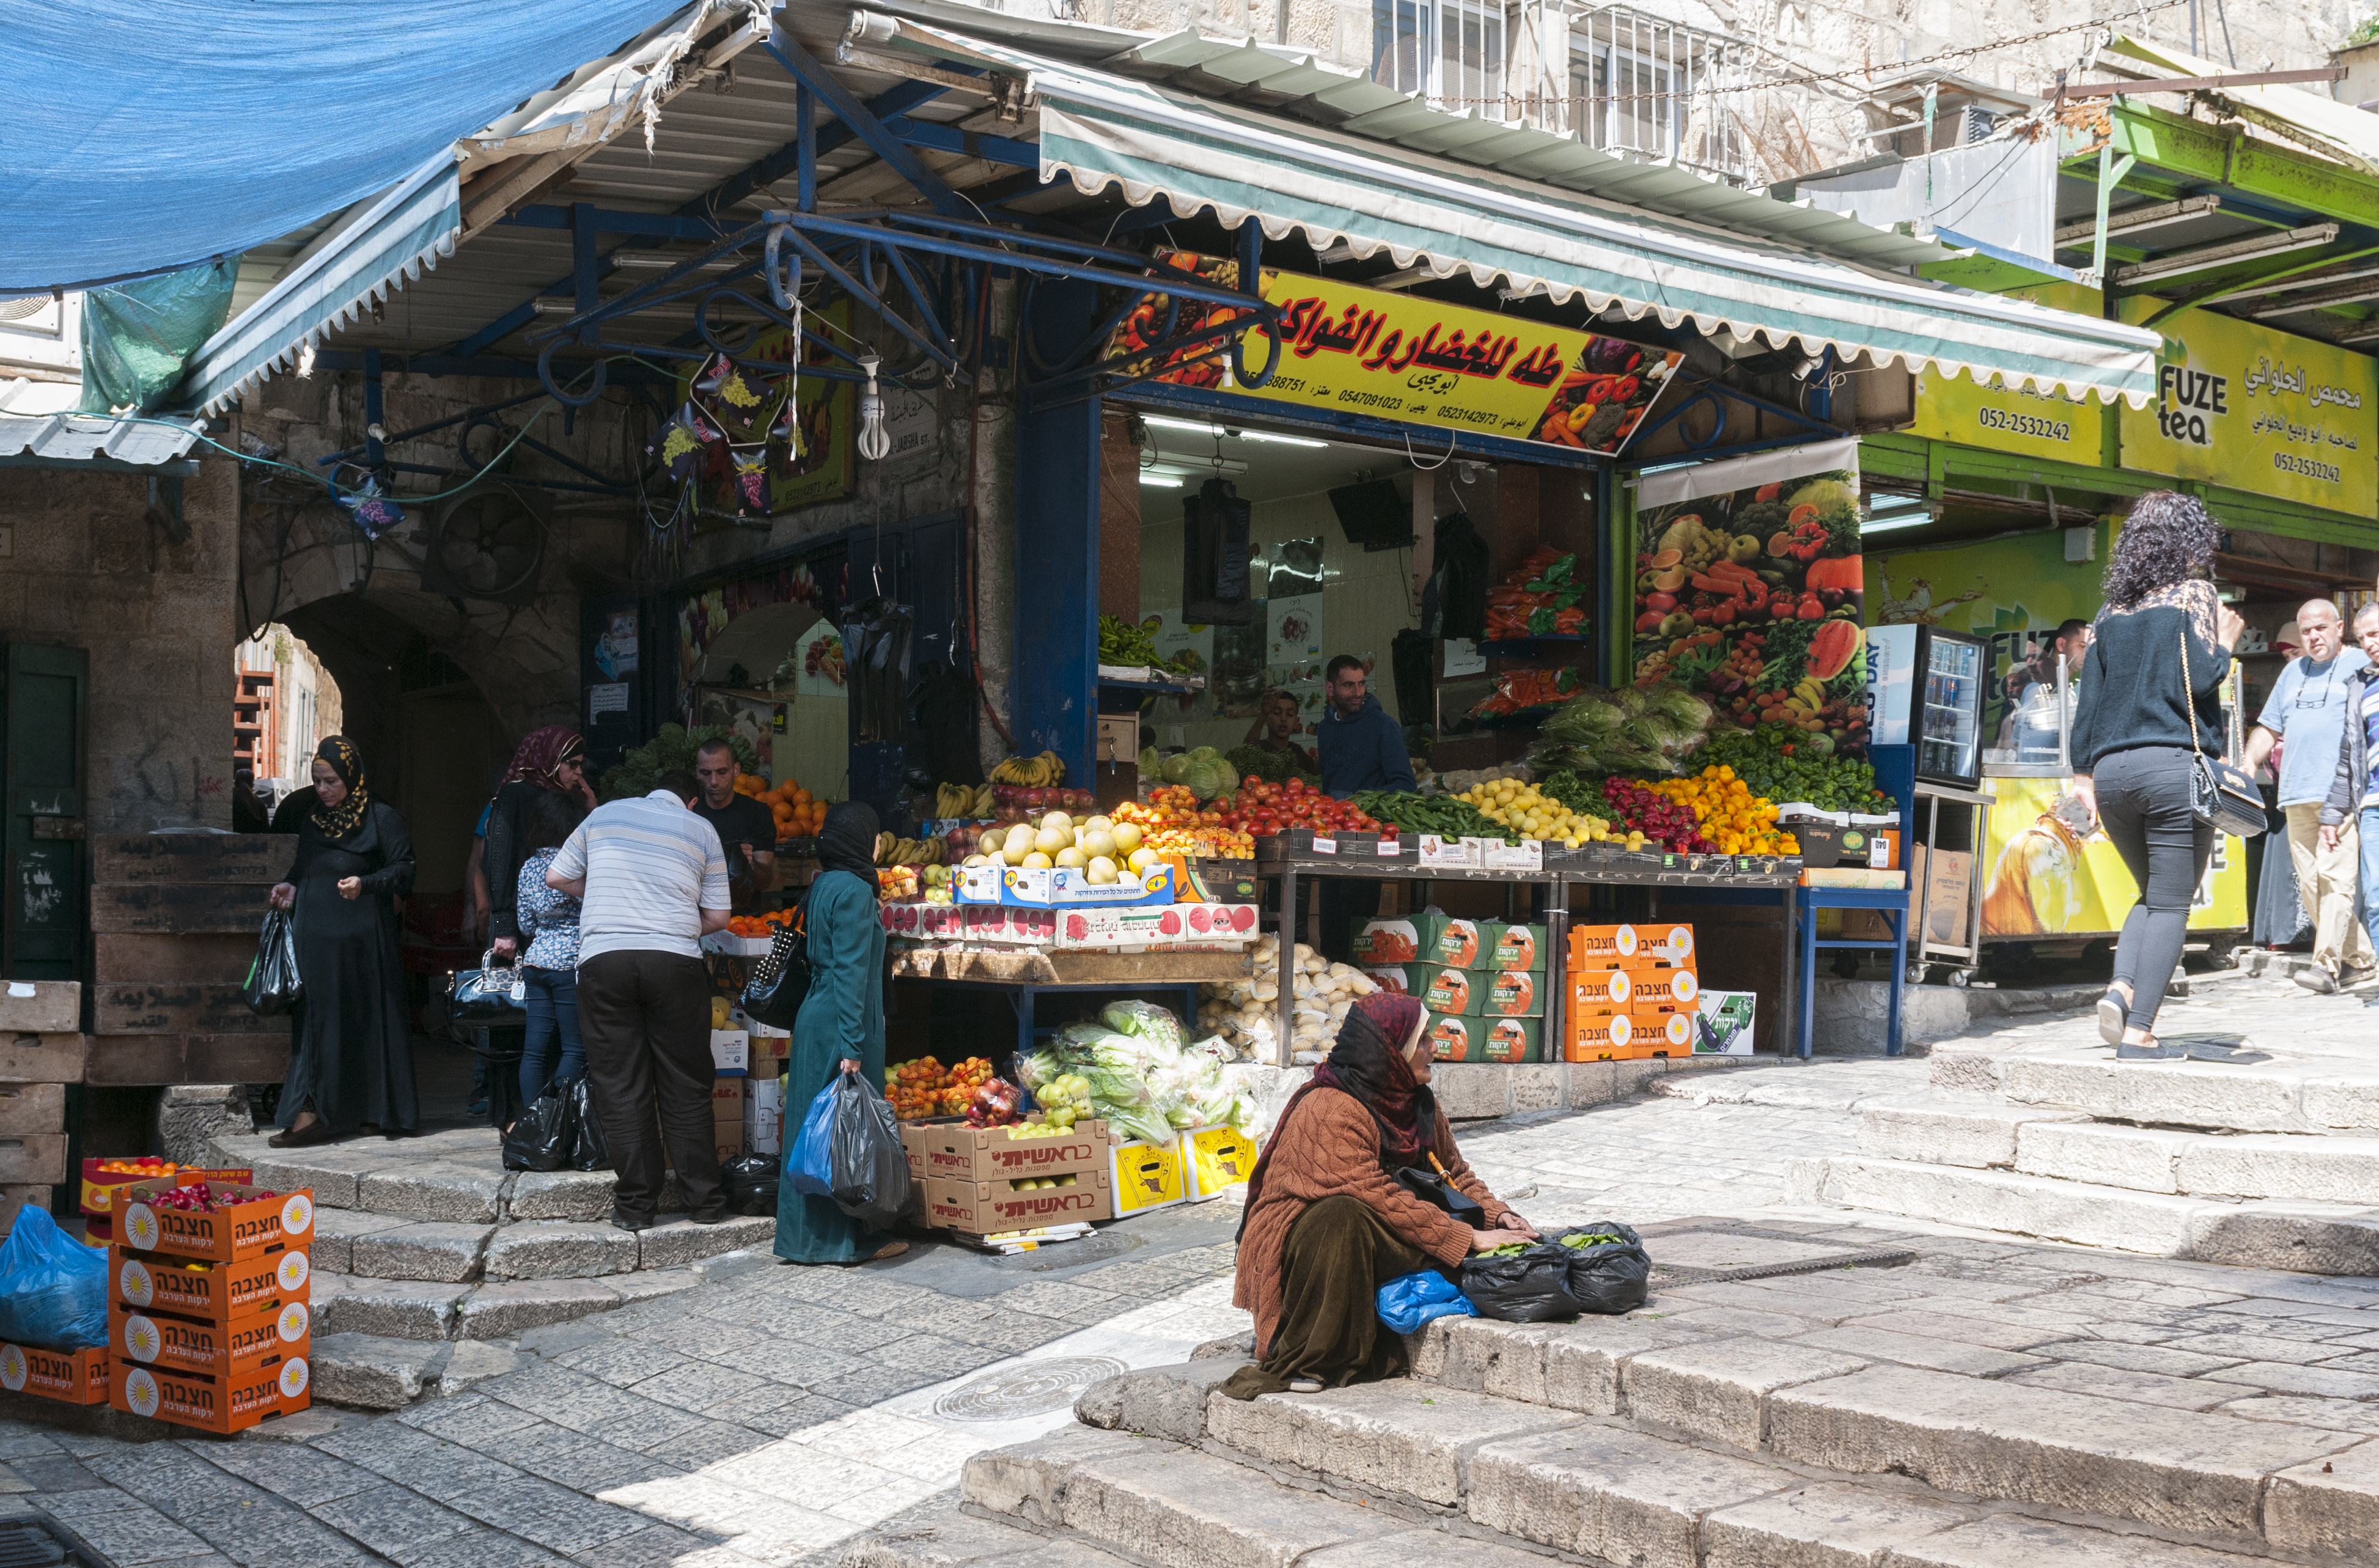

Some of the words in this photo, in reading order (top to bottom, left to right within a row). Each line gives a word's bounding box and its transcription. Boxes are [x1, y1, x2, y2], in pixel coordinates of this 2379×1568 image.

[1388, 323, 1518, 380] للخضار
[1508, 343, 1563, 388] طه
[2245, 356, 2305, 397] الحلواني
[2159, 365, 2227, 414] FUZE
[1338, 389, 1403, 410] 0547091023
[2309, 385, 2361, 410] محمص
[1437, 406, 1498, 425] 0523142973
[1979, 407, 2070, 441] 052-2532242
[2158, 403, 2207, 445] tea
[921, 433, 929, 445] ST.
[2274, 451, 2340, 483] 052-2532242
[1866, 641, 1880, 683] DAY
[1882, 644, 1891, 681] ENERGY
[1875, 840, 1887, 849] 040
[1441, 938, 1462, 948] ירקות
[1587, 937, 1616, 950] חצבה
[1498, 948, 1518, 956] ירקות
[1430, 990, 1451, 999] ירקות
[1579, 984, 1609, 996] חצבה
[1635, 983, 1671, 996] חצבה
[1715, 1017, 1737, 1032] ירקות
[1579, 1028, 1609, 1040] חצבה
[1631, 1026, 1666, 1039] חצבה
[1489, 1040, 1509, 1050] ירקות
[1720, 1029, 1737, 1051] מובחרים
[933, 1152, 971, 1168] בראשית
[1001, 1144, 1090, 1167] בראשית
[1024, 1163, 1049, 1172] מפסגות
[935, 1202, 973, 1220] בראשית
[1004, 1193, 1093, 1217] בראשית
[1027, 1213, 1052, 1222] מפסגות
[161, 1214, 214, 1238] חצבה
[235, 1215, 281, 1239] חצבה
[164, 1233, 189, 1243] הערבה
[237, 1235, 260, 1246] הערבה
[262, 1229, 281, 1242] ירקות
[192, 1239, 215, 1248] ירקות
[156, 1272, 209, 1296] חצבה
[231, 1271, 276, 1297] חצבה
[159, 1291, 185, 1301] הערבה
[232, 1292, 256, 1304] הערבה
[257, 1286, 277, 1299] ירקות
[188, 1296, 210, 1306] ירקות
[165, 1327, 213, 1352] חצבה
[232, 1323, 277, 1349] חצבה
[233, 1344, 257, 1356] הערבה
[257, 1338, 277, 1350] ירקות
[166, 1345, 191, 1357] הערבה
[193, 1352, 215, 1361] ירקות
[30, 1356, 72, 1380] חצבה
[90, 1361, 109, 1378] בה
[31, 1374, 52, 1385] הערבה
[54, 1380, 73, 1389] ירקות
[91, 1376, 109, 1385] ערבה
[163, 1382, 214, 1409] חצבה
[232, 1379, 278, 1403] חצבה
[233, 1400, 257, 1412] הערבה
[259, 1393, 278, 1407] ירקות
[164, 1401, 189, 1413] הערבה
[192, 1407, 215, 1418] ירקות
